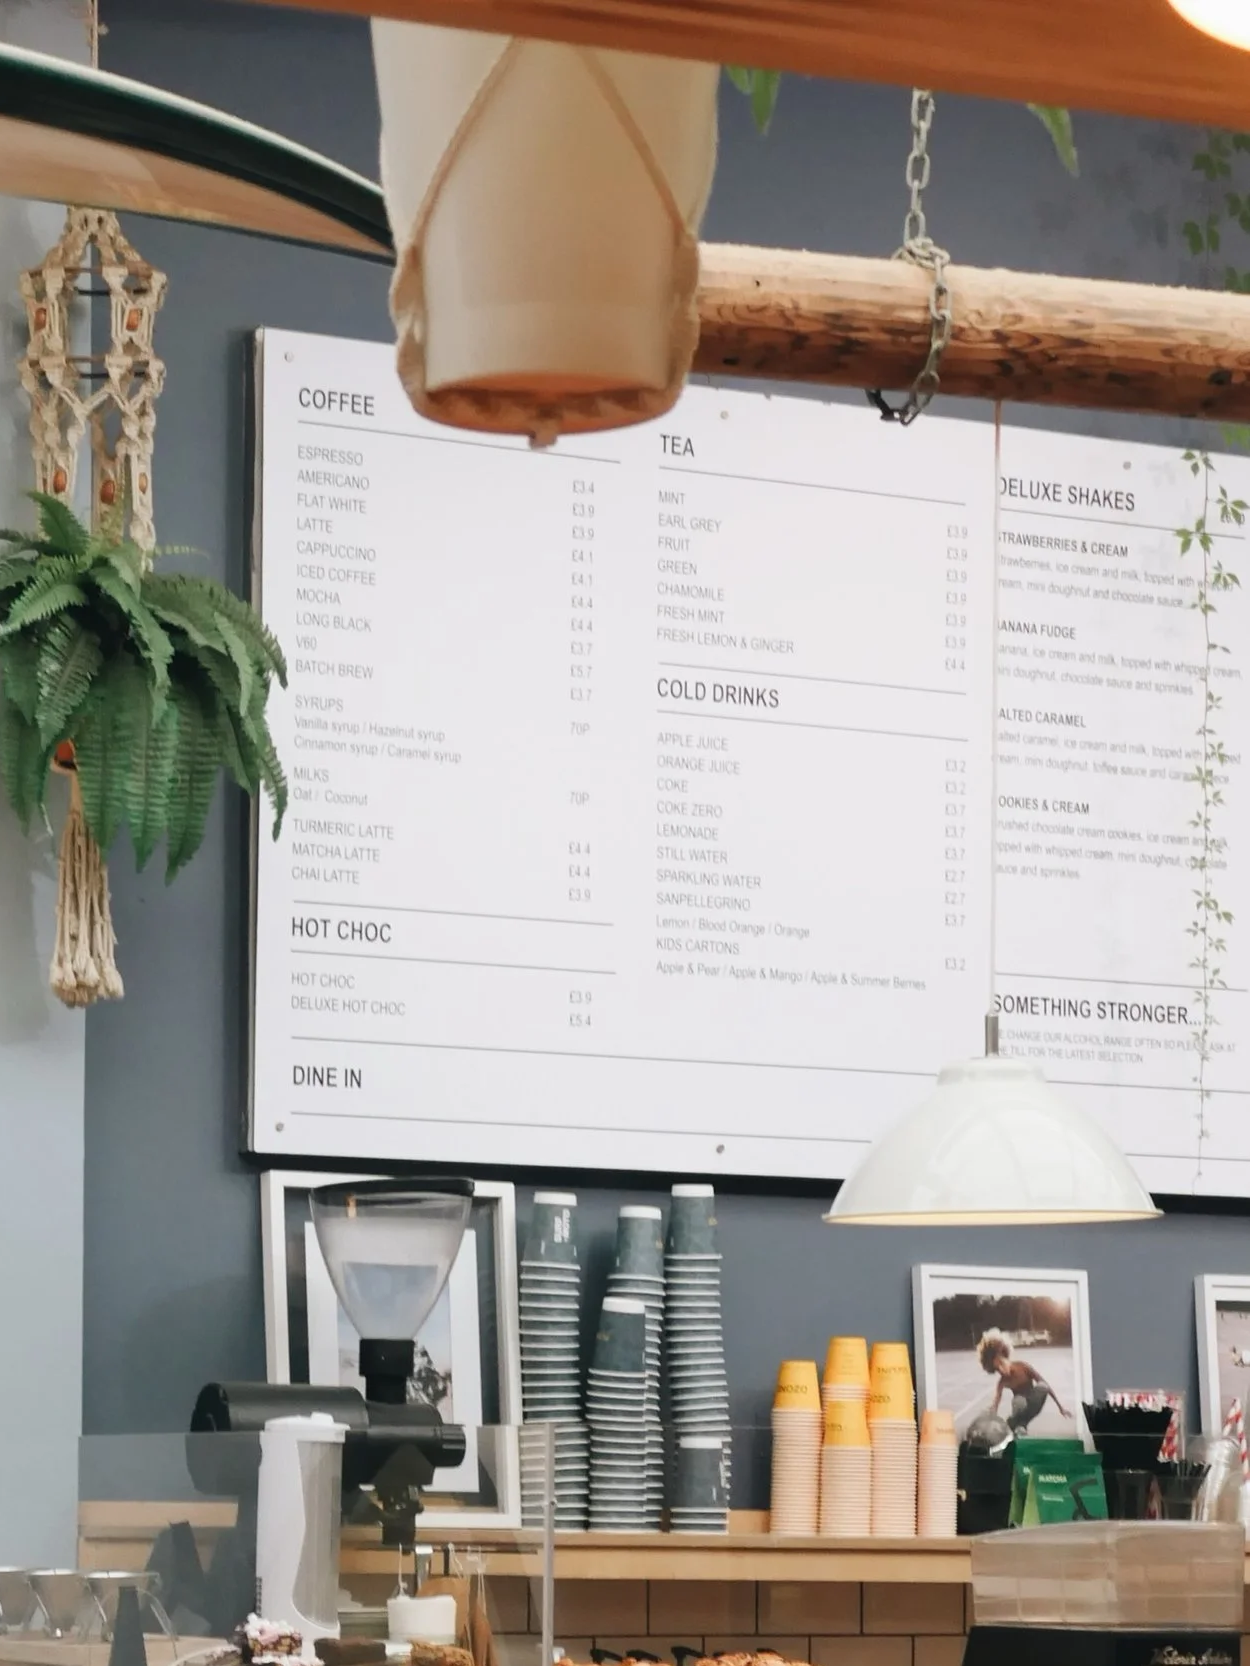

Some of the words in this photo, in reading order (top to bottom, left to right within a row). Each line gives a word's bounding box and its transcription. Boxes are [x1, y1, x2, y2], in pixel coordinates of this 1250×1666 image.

[298, 387, 374, 416] COFFEE
[297, 444, 364, 467] ESPRESSO
[660, 433, 695, 458] TEA
[297, 469, 370, 491] AMERICANO
[297, 492, 326, 512] FLAT
[327, 495, 367, 515] WHITE
[657, 488, 686, 508] MINT
[999, 476, 1062, 503] DELUXE
[1067, 485, 1135, 512] SHAKES
[296, 516, 334, 537] LATTE
[658, 511, 688, 531] EARL
[689, 516, 722, 533] GREY
[296, 539, 377, 563] CAPPUCCINO
[657, 535, 691, 553] FRUIT
[999, 531, 1078, 552] TRAWBERRIES
[1090, 541, 1128, 558] CREAM
[296, 563, 326, 582] ICED
[327, 566, 376, 587] COFFEE
[657, 556, 698, 579] GREEN
[657, 580, 725, 602] CHAMOMILE
[998, 578, 1024, 591] ream,
[296, 587, 342, 608] MOCHA
[296, 610, 331, 629] LONG
[331, 614, 372, 633] BLACK
[656, 603, 696, 624] FRESH
[696, 607, 725, 626] MINT
[656, 626, 695, 644] FRESH
[697, 630, 738, 649] LEMON
[750, 636, 794, 654] GINGER
[998, 619, 1038, 635] ANANA
[1040, 623, 1076, 640] FUDGE
[295, 634, 318, 652] V60
[295, 657, 335, 676] BATCH
[338, 662, 374, 680] BREW
[294, 693, 344, 714] SYRUPS
[657, 677, 706, 701] COLD
[712, 683, 779, 709] DRINKS
[998, 707, 1033, 723] ALTED
[1035, 710, 1086, 728] CARAMEL
[332, 721, 360, 737] syrup
[417, 729, 445, 745] syrup
[656, 731, 695, 749] APPLE
[695, 734, 729, 752] JUICE
[350, 742, 378, 758] syrup
[433, 750, 462, 765] syrup
[293, 765, 330, 785] MILKS
[656, 754, 707, 773] ORANGE
[708, 759, 740, 776] JUICE
[656, 774, 690, 796] COKE
[656, 798, 689, 818] COKE
[690, 801, 724, 820] ZERO
[998, 795, 1039, 811] OOKIES
[1052, 800, 1090, 815] CREAM
[292, 817, 355, 837] TURMERIC
[358, 824, 394, 841] LATTE
[656, 821, 719, 842] LEMONADE
[292, 841, 342, 860] MATCHA
[344, 845, 380, 863] LATTE
[656, 844, 687, 862] STILL
[688, 847, 729, 866] WATER
[291, 865, 321, 881] CHAI
[323, 867, 360, 886] LATTE
[655, 868, 720, 889] SPARKLING
[721, 873, 762, 890] WATER
[655, 891, 751, 912] SANPELLEGRINO
[291, 916, 331, 939] HOT
[337, 920, 391, 943] CHOC
[655, 936, 683, 953] KIDS
[685, 937, 740, 956] CARTONS
[291, 971, 317, 987] HOT
[319, 972, 355, 991] CHOC
[291, 994, 339, 1013] DELUXE
[342, 998, 368, 1014] HOT
[370, 1000, 406, 1017] CHOC
[994, 994, 1091, 1017] SOMETHING
[293, 1065, 337, 1088] DINE
[344, 1068, 362, 1089] IN
